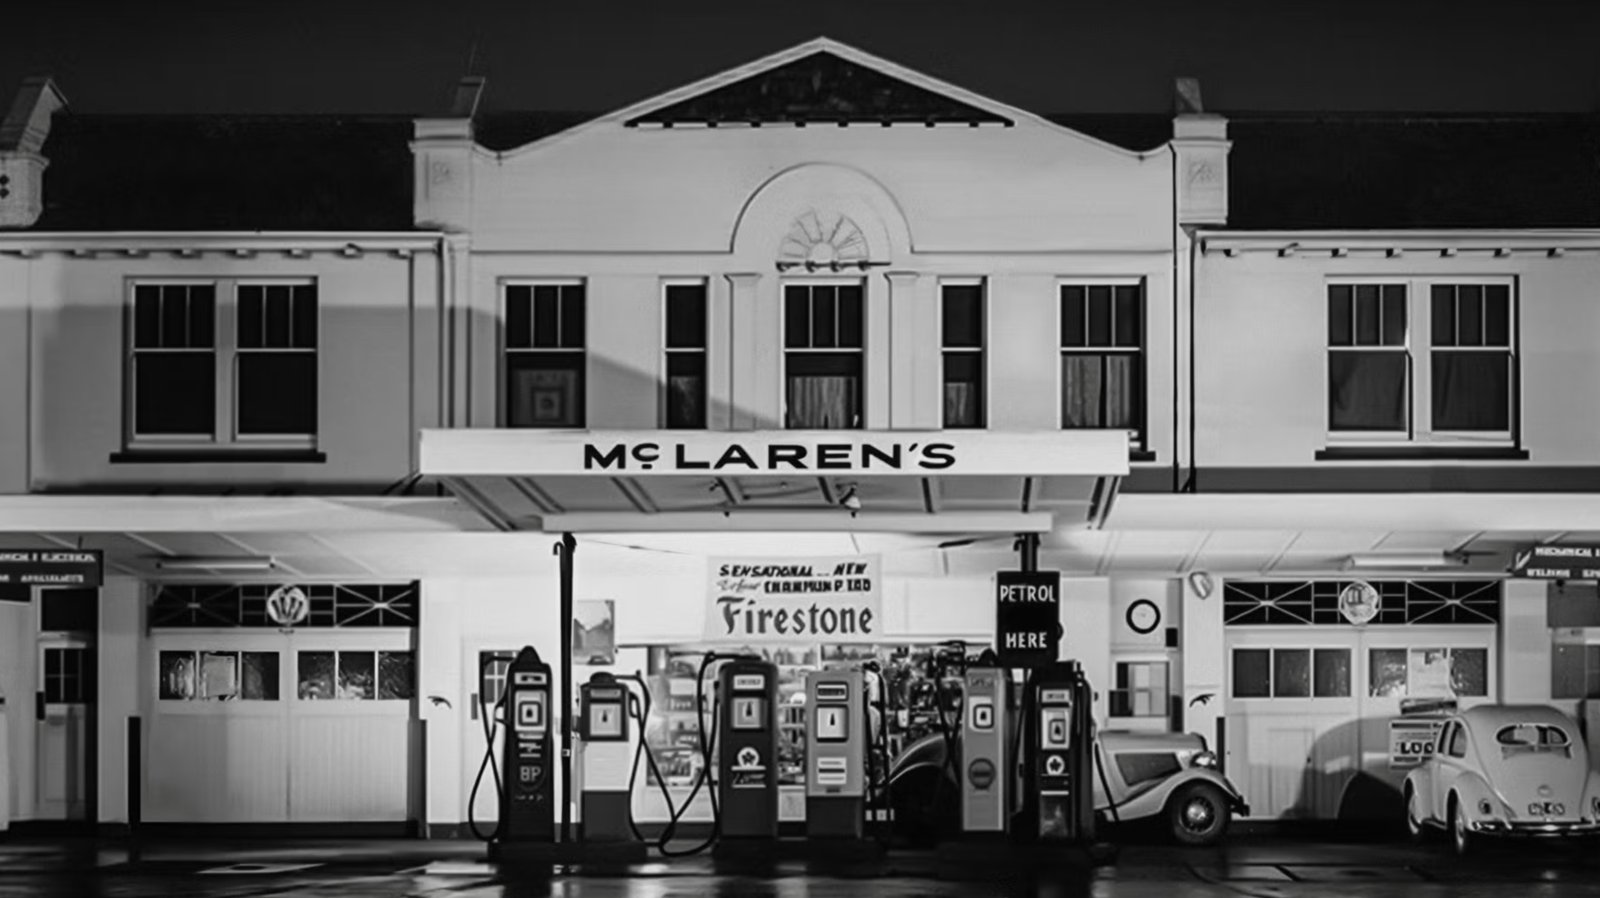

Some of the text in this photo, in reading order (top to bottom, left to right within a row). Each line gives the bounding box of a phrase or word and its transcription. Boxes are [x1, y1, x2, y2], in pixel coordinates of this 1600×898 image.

[719, 562, 867, 577] SENSATIONAL NEW
[1000, 584, 1056, 602] PETROL
[716, 595, 873, 635] Firestone
[1006, 631, 1048, 649] HERE
[520, 765, 542, 781] BP
